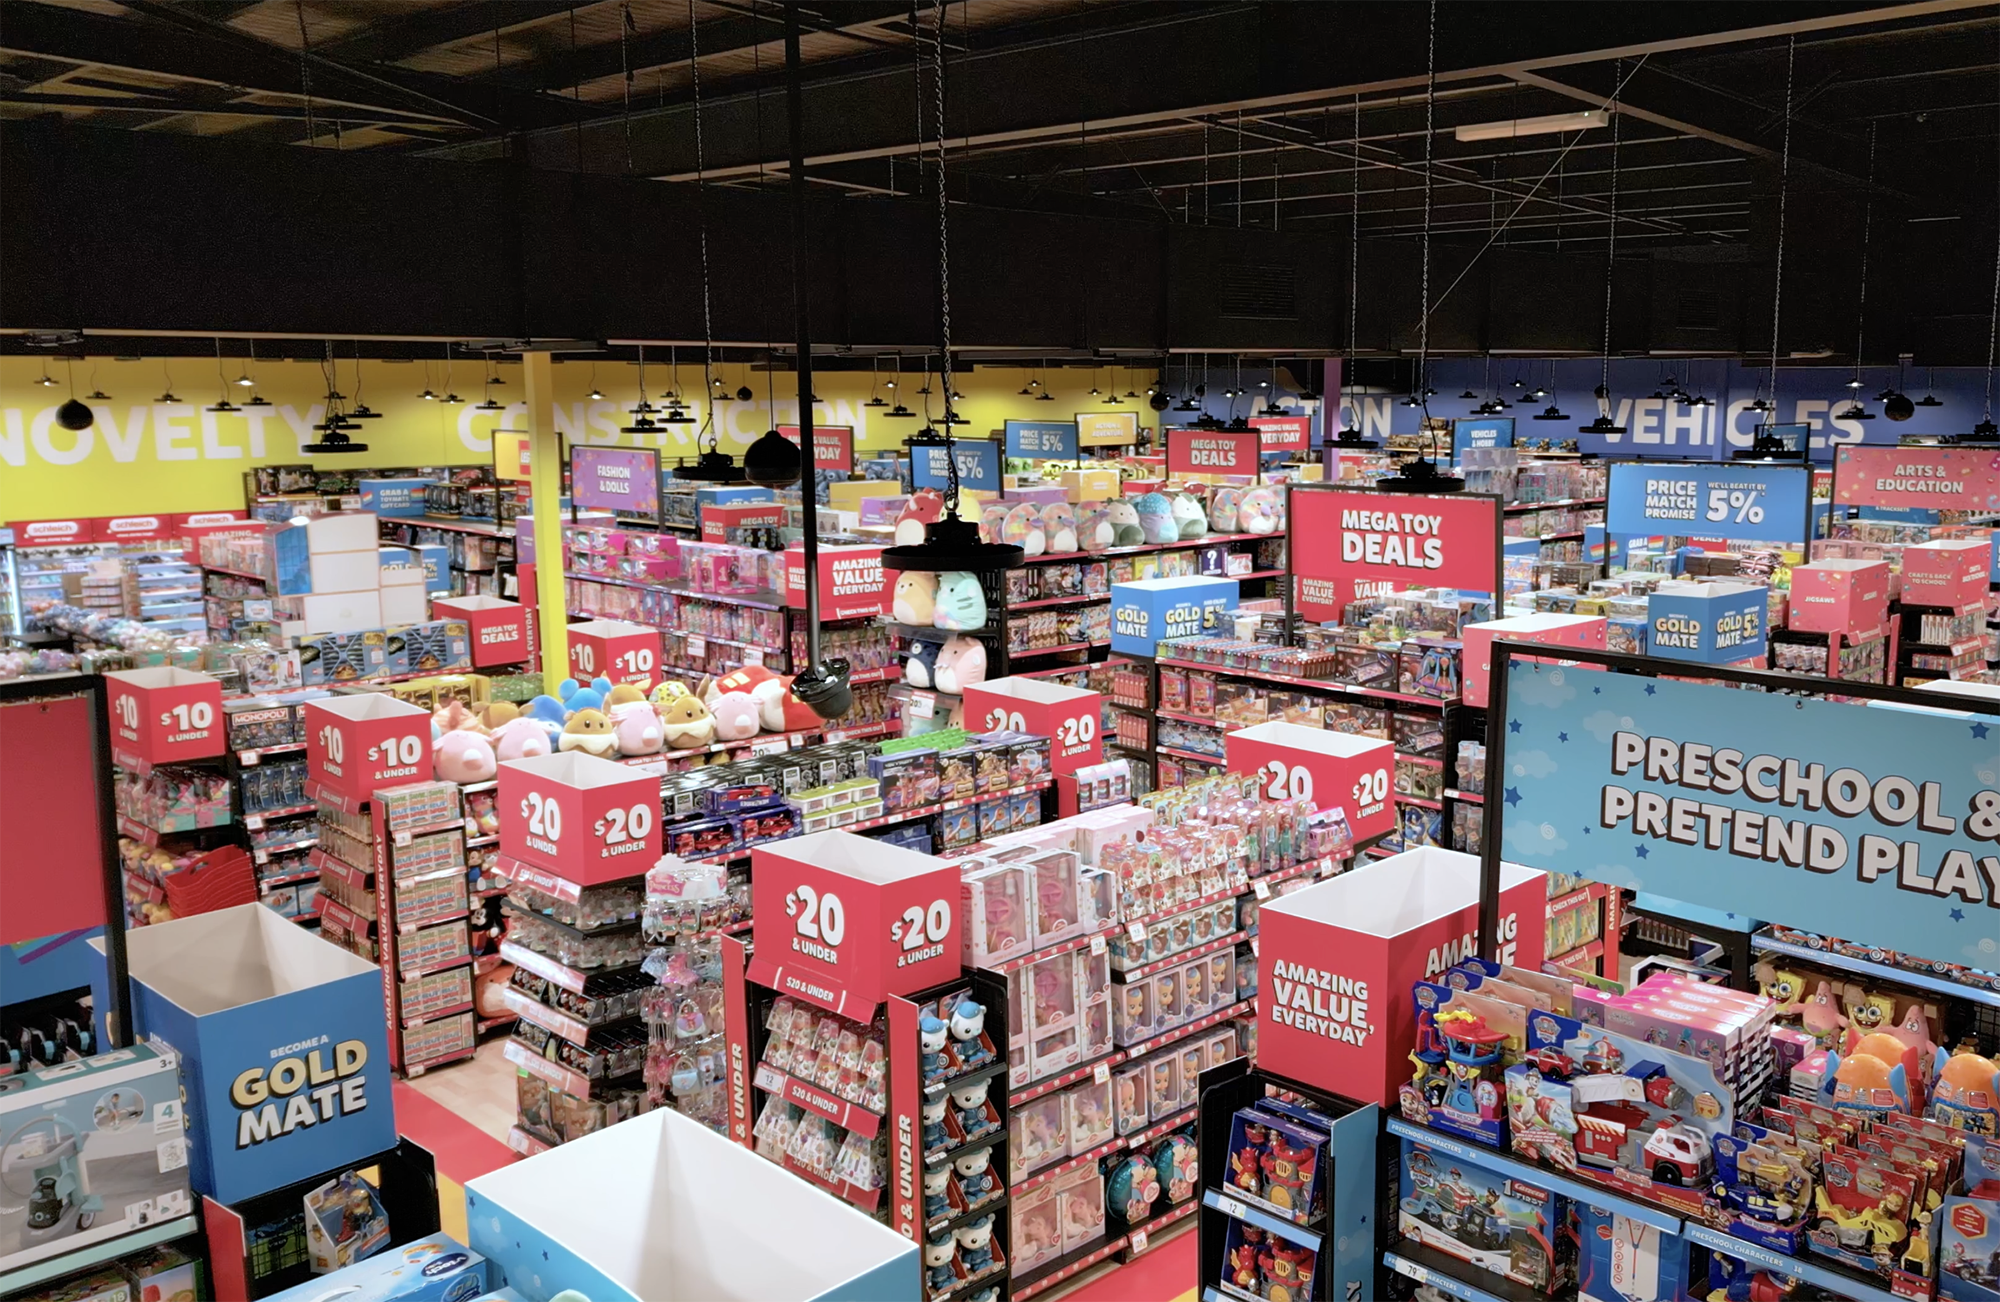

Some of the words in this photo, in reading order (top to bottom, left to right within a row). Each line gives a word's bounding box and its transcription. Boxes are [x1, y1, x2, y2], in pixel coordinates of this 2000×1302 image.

[1019, 429, 1039, 438] PRICE
[1470, 429, 1497, 438] VEHICLES
[1190, 439, 1217, 449] MEGA
[1218, 440, 1236, 450] TOY
[1476, 439, 1495, 447] HOBBY
[1190, 450, 1237, 466] DEALS
[597, 465, 631, 479] FASHION
[1893, 464, 1934, 477] ARTS
[1936, 466, 1946, 478] &
[380, 489, 403, 497] GRAB
[599, 480, 606, 491] &
[605, 481, 630, 494] DOLLS
[1646, 479, 1697, 496] PRICE
[1729, 482, 1748, 490] BEAT
[1875, 478, 1963, 493] EDUCATION
[1645, 495, 1697, 509] MATCH
[740, 517, 762, 525] MEGA
[762, 516, 778, 524] TOY
[1341, 509, 1399, 532] MEGA
[1401, 513, 1442, 535] TOY
[1645, 508, 1696, 520] PROMISE
[33, 524, 72, 533] schleich
[115, 519, 154, 528] schleich
[705, 527, 723, 535] DEALS
[1342, 532, 1443, 569] DEALS
[833, 570, 886, 585] VALUE,
[1302, 578, 1334, 589] AMAZING
[833, 582, 884, 596] EVERYDAY
[1805, 596, 1836, 604] JIGSAWS
[1116, 609, 1149, 625] GOLD
[1165, 607, 1200, 624] GOLD
[1716, 615, 1742, 633] GOLD
[481, 626, 501, 634] MEGA
[501, 624, 517, 632] TOY
[1116, 622, 1147, 638] MATE
[1166, 621, 1199, 639] MATE
[1656, 618, 1701, 634] GOLD
[481, 631, 519, 644] DEALS
[1655, 633, 1698, 649] MATE
[1716, 631, 1741, 650] MATE
[570, 643, 595, 673] $10
[616, 649, 654, 673] $10
[116, 694, 137, 730] $10
[161, 703, 213, 731] $10
[235, 708, 287, 725] MONOPOLY
[167, 734, 175, 742] &
[175, 730, 209, 742] UNDER
[1057, 714, 1095, 746] $20
[319, 725, 343, 765] $10
[368, 735, 422, 766] $10
[1062, 747, 1067, 756] &
[1067, 743, 1091, 756] UNDER
[328, 762, 342, 778] UNDER
[374, 771, 382, 780] &
[383, 766, 418, 778] UNDER
[1258, 760, 1314, 803] $20
[1352, 768, 1388, 806] $20
[1611, 730, 1956, 836] PRESCHOOL
[1962, 789, 2000, 842] &
[521, 792, 561, 843] $20
[1357, 811, 1362, 820] &
[1362, 802, 1385, 819] UNDER
[594, 803, 652, 844] $20
[1600, 784, 1849, 875] PRETEND
[526, 836, 532, 847] &
[532, 838, 557, 857] UNDER
[601, 847, 609, 857] &
[609, 840, 646, 857] UNDER
[376, 834, 388, 910] EVERYDAY
[1552, 900, 1568, 912] CHECK
[1568, 896, 1577, 906] THIS
[1577, 892, 1587, 903] OUT
[785, 885, 844, 948] $20
[891, 899, 951, 950] $20
[380, 911, 390, 966] VALUE,
[792, 938, 801, 952] &
[801, 942, 838, 965] UNDER
[897, 954, 906, 968] &
[906, 945, 944, 966] UNDER
[1272, 959, 1369, 999] AMAZING
[786, 976, 801, 990] $20
[800, 982, 807, 992] &
[807, 984, 834, 1002] UNDER
[384, 967, 393, 1030] AMAZING
[1272, 979, 1374, 1036] VALUE,
[1272, 1005, 1367, 1048] EVERYDAY
[270, 1038, 319, 1058] BECOME
[319, 1034, 330, 1044] A
[160, 1059, 173, 1069] 3+
[230, 1039, 368, 1110] GOLD
[732, 1043, 746, 1119] UNDER
[765, 1074, 774, 1084] 12
[791, 1085, 806, 1099] $20
[805, 1091, 812, 1102] &
[812, 1093, 839, 1114] UNDER
[161, 1104, 174, 1119] 4
[235, 1076, 368, 1151] MATE
[1392, 1124, 1424, 1141] PRESCHOOL
[1425, 1136, 1462, 1154] CHARACTERS
[899, 1114, 913, 1198] UNDER
[1229, 1202, 1237, 1214] 12
[1515, 1193, 1544, 1208] FIRST
[901, 1203, 913, 1220] &
[1691, 1230, 1734, 1252] PRESCHOOL
[1734, 1245, 1784, 1267] CHARACTERS
[1408, 1265, 1417, 1277] 79
